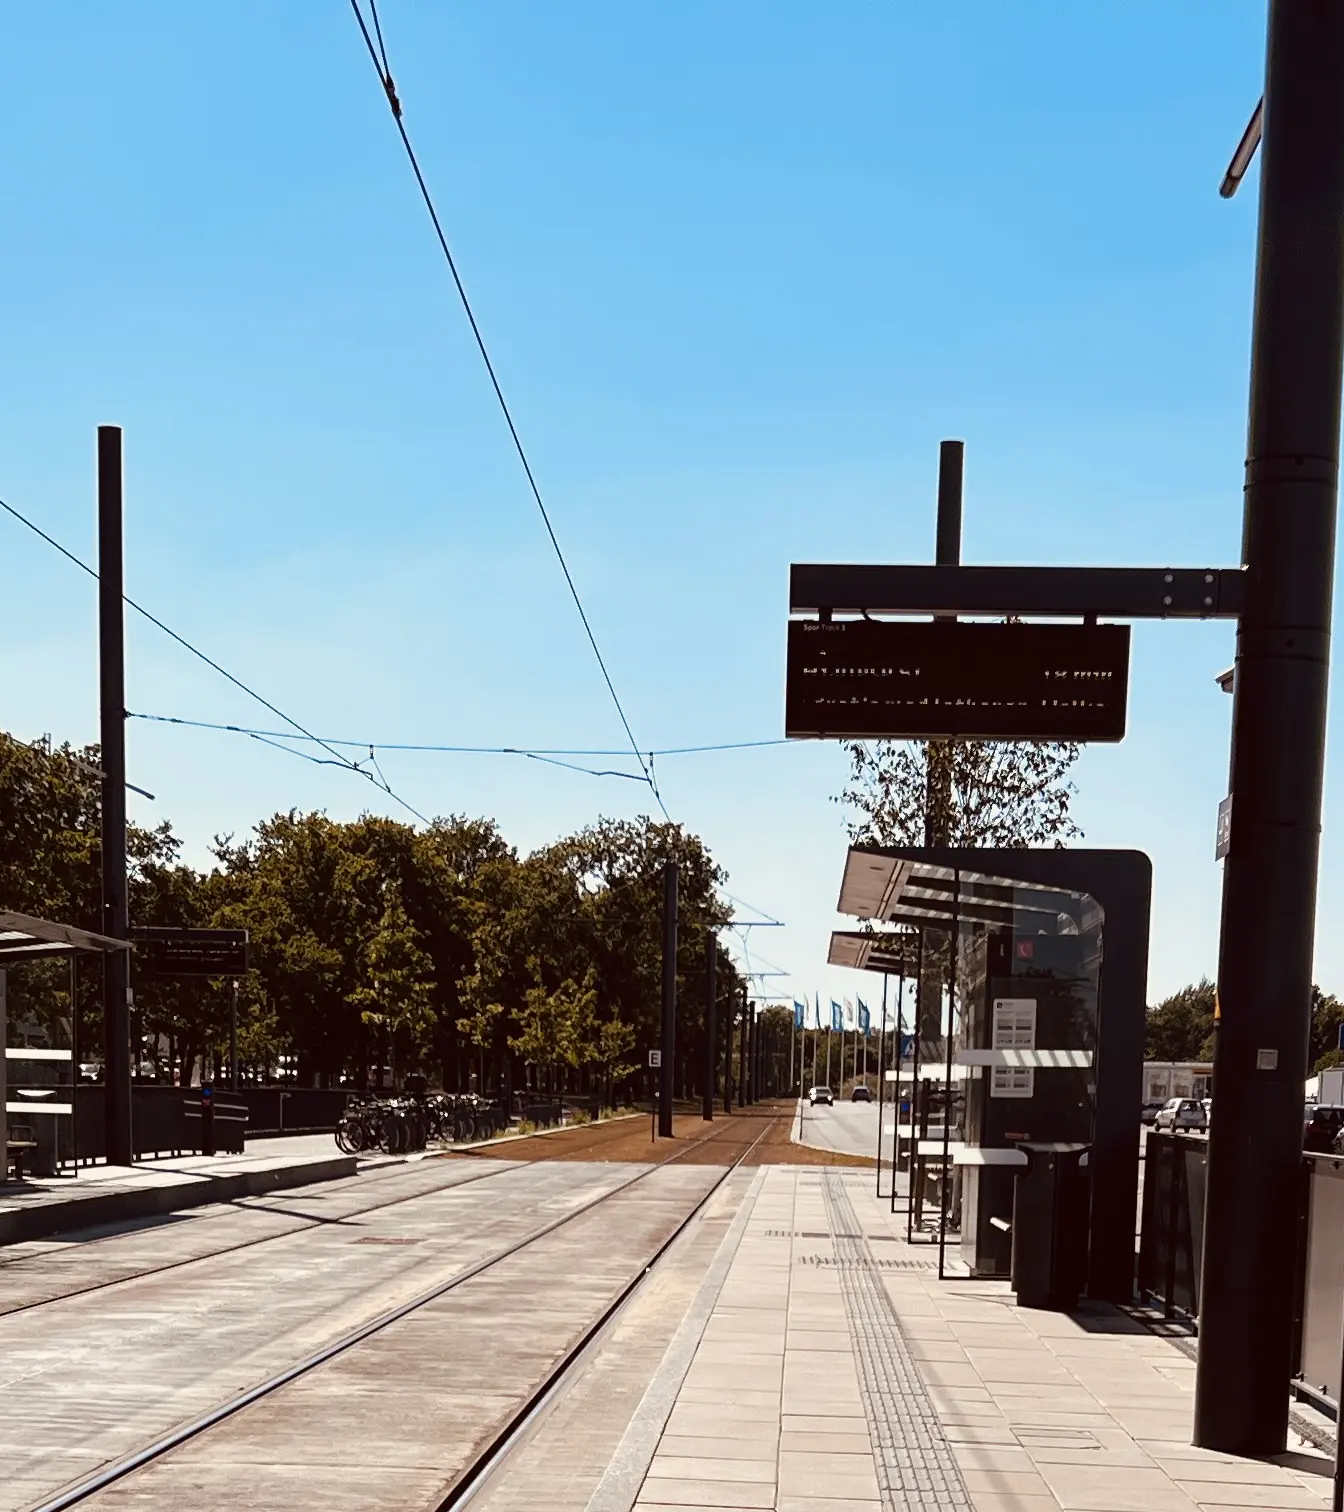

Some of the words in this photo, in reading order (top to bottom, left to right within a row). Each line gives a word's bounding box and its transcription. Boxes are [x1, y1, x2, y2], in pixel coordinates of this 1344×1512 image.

[803, 623, 819, 632] Spor
[821, 623, 840, 632] Track
[651, 1052, 659, 1065] E
